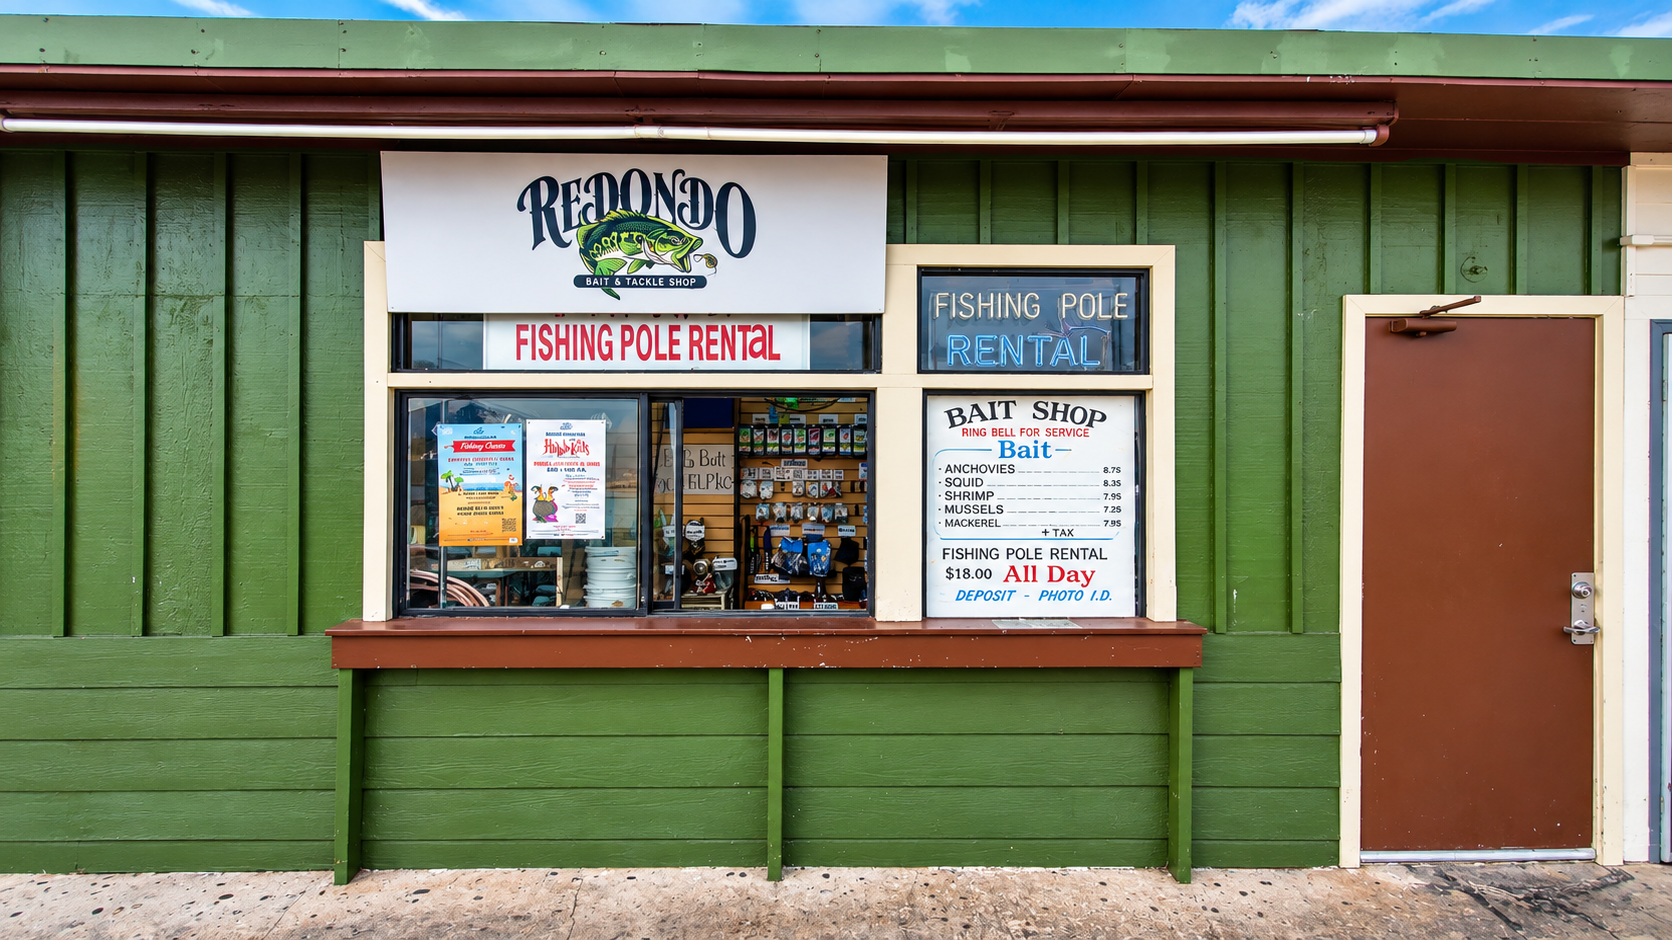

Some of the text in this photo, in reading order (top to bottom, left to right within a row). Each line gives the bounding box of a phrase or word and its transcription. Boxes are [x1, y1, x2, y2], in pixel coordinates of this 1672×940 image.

[517, 168, 757, 259] REDONDO
[586, 277, 696, 287] BAIT & TACKLE SHOP
[933, 292, 1128, 320] FISHING POLE
[516, 324, 613, 361] FISHING
[620, 324, 681, 361] POLE
[947, 334, 1100, 367] RENTAL
[944, 400, 1107, 429] BAIT SHOP
[962, 428, 1090, 437] RING BELL FOR SERVICE
[998, 440, 1052, 459] Bait
[944, 464, 1015, 474] ANCHOVIES
[944, 477, 984, 487] SQUID
[944, 491, 994, 501] SHRIMP
[944, 505, 1004, 514] MUSSELS
[944, 519, 1001, 527] MACKEREL
[1052, 529, 1074, 537] TAX
[942, 548, 1108, 560] FISHING POLE RENTAL
[945, 565, 1095, 588] $18.00 All Day
[955, 590, 1017, 601] DEPOSIT
[1038, 590, 1084, 601] PHOTO
[1090, 590, 1112, 601] I.D.
